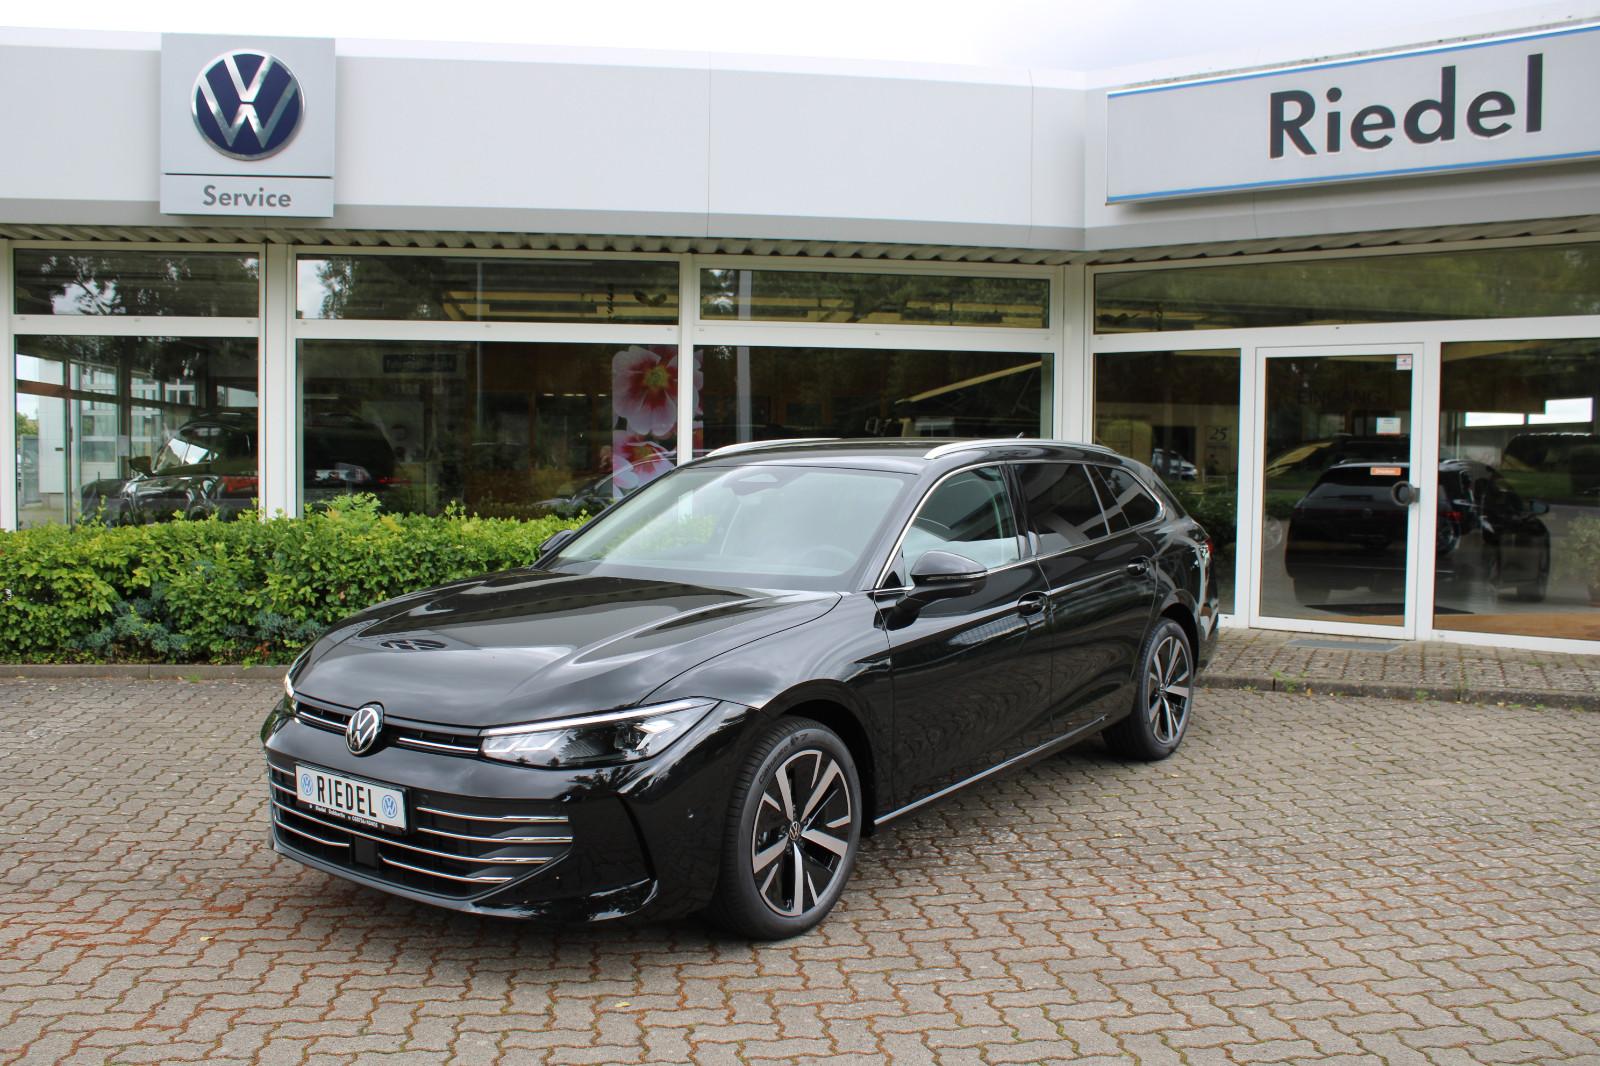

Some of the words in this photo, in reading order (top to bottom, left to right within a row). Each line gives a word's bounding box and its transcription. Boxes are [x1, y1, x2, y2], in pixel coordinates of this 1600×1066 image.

[1269, 53, 1544, 159] Riedel
[203, 184, 292, 208] Service
[316, 775, 377, 818] RIEDEL
